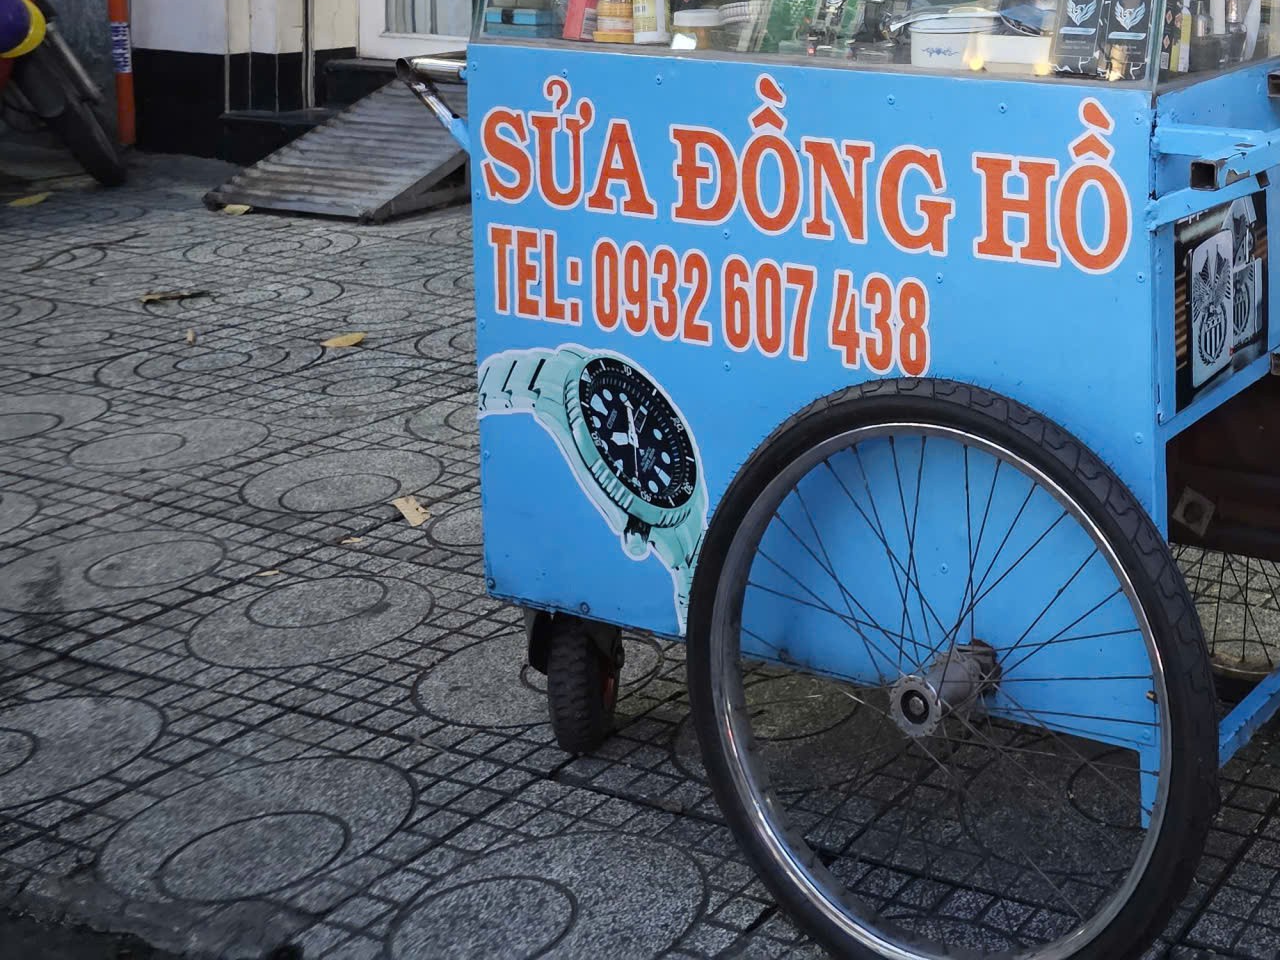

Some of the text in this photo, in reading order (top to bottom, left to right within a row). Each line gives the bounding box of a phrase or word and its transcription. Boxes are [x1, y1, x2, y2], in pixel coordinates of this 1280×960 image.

[480, 73, 1132, 275] SỬA ĐỒNG HỒ
[488, 224, 930, 377] TEL: 0932 607 438
